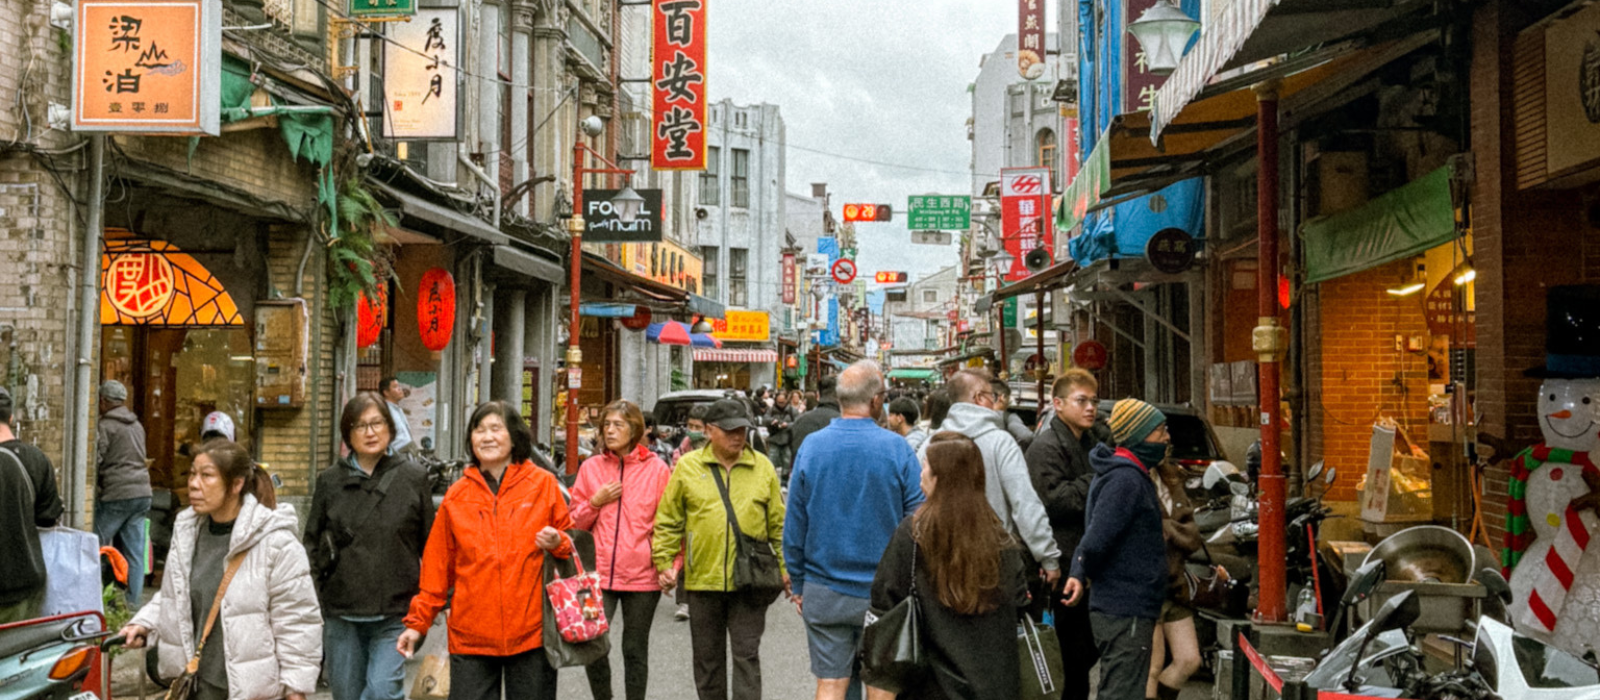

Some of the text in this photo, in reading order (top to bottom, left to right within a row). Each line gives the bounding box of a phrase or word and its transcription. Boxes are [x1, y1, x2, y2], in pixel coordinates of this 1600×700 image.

[655, 0, 703, 161] 百安堂
[588, 200, 652, 216] FOL
[913, 198, 964, 208] 民生西路
